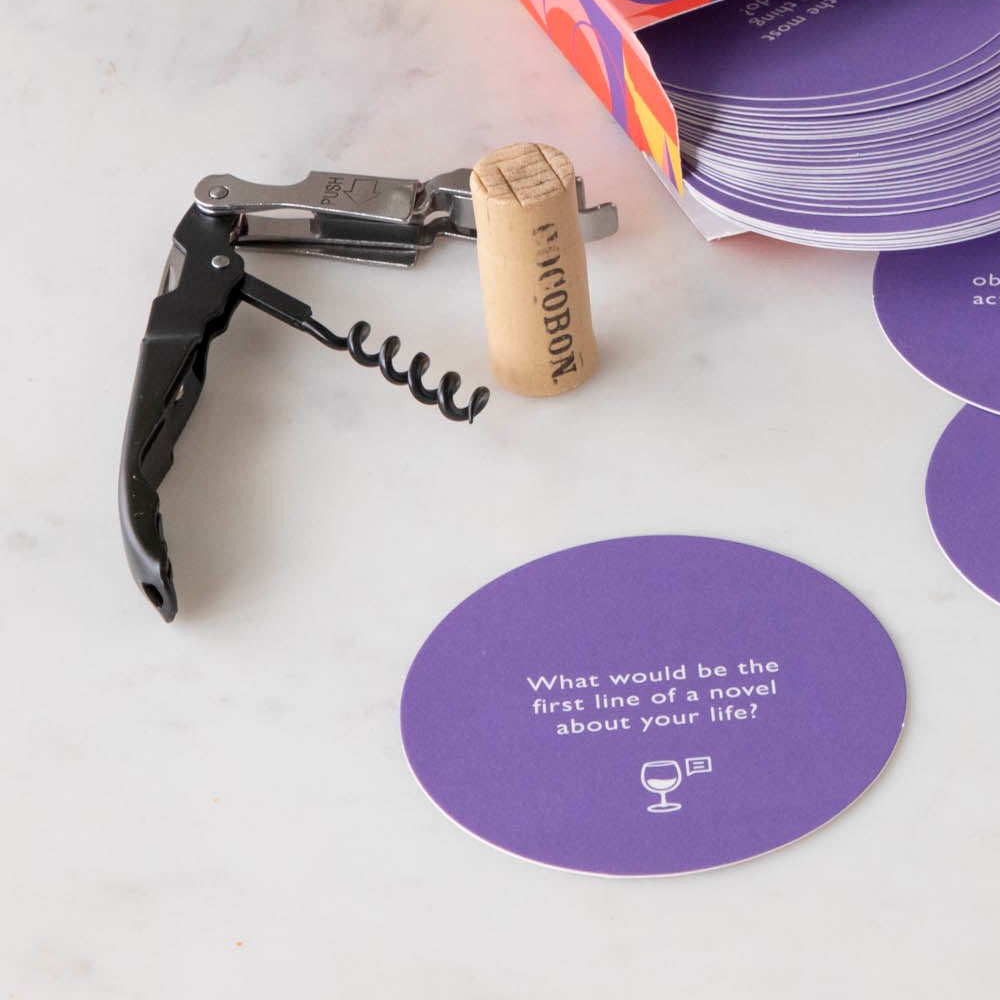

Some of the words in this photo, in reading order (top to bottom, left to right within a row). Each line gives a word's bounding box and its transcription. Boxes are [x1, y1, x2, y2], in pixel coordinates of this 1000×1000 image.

[748, 2, 797, 27] thing
[761, 15, 806, 41] most
[320, 176, 345, 206] PUSH
[526, 673, 600, 692] What
[609, 664, 687, 686] would
[698, 663, 728, 679] be
[737, 658, 780, 676] the
[532, 698, 585, 715] first
[595, 693, 641, 710] line
[650, 687, 678, 705] of
[686, 689, 699, 702] a
[709, 679, 777, 701] novel
[556, 715, 631, 735] about
[640, 711, 700, 733] your
[709, 703, 759, 723] life?
